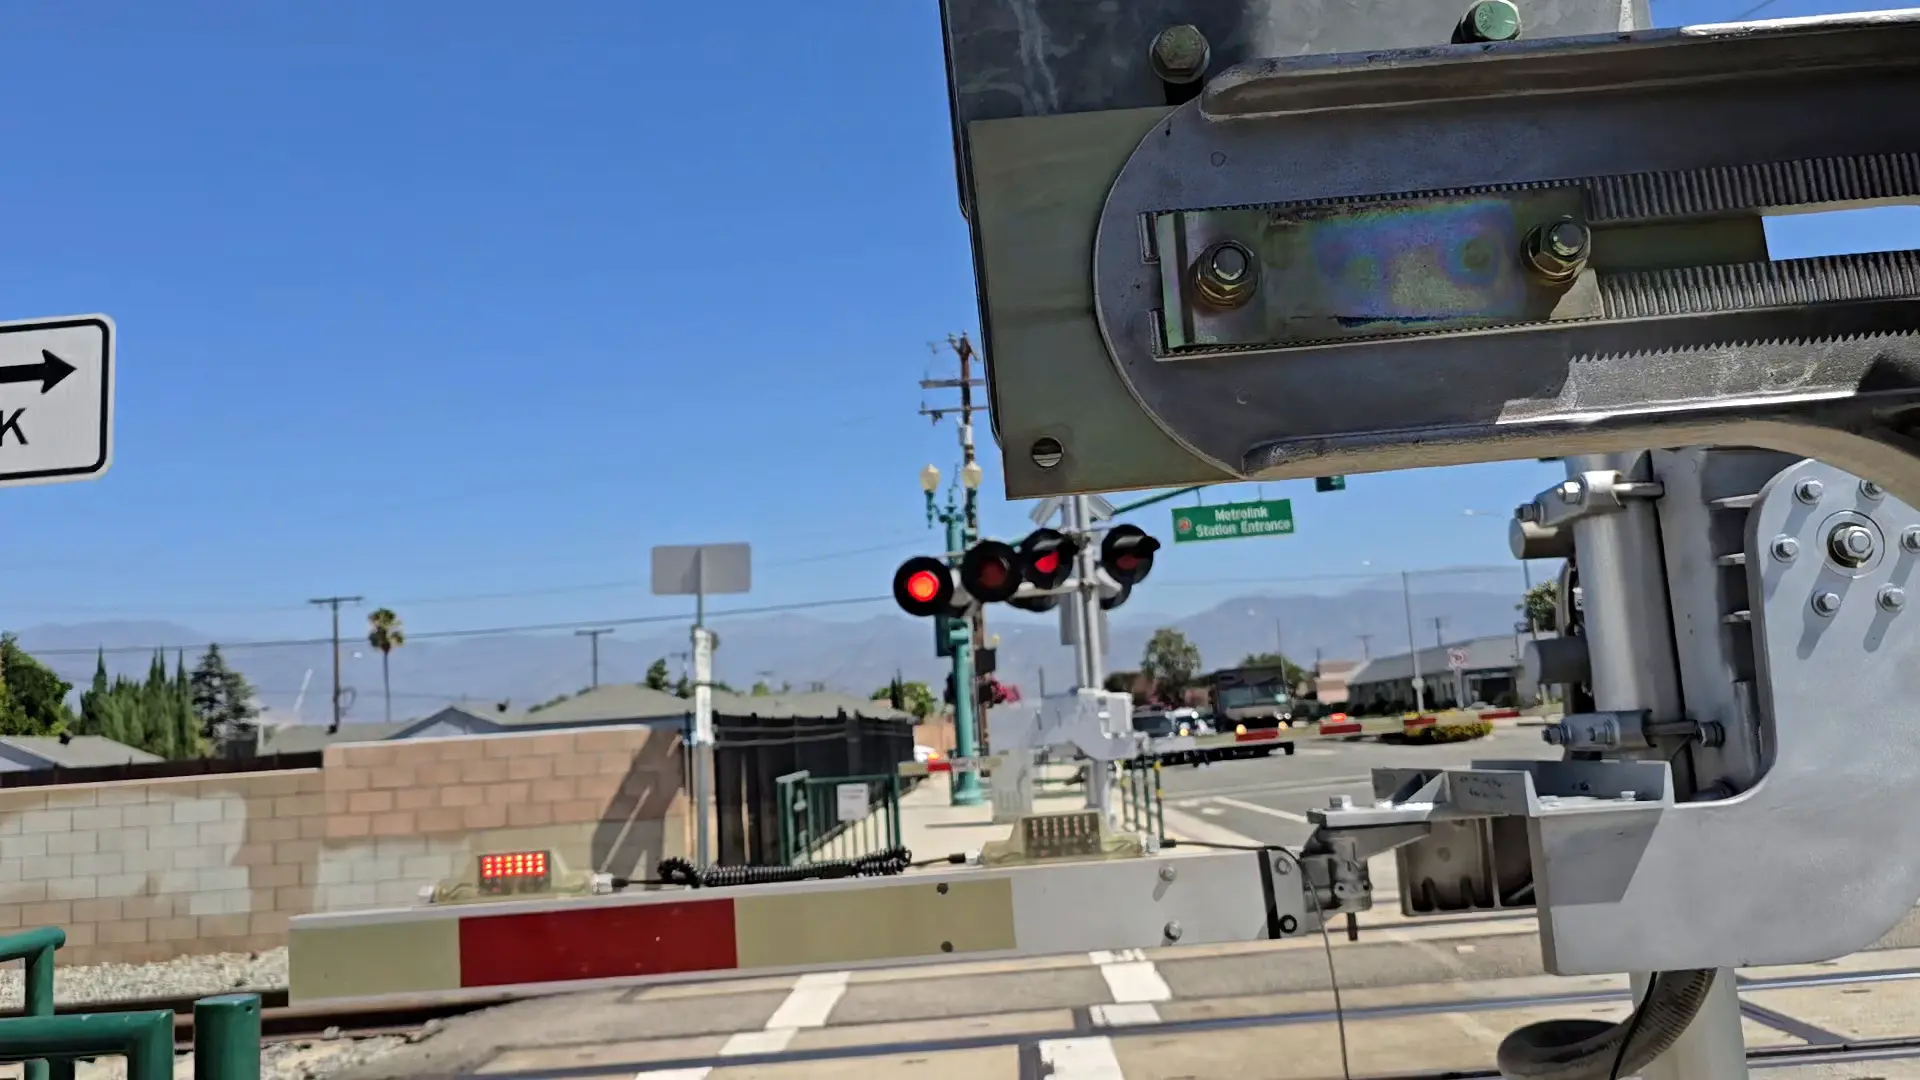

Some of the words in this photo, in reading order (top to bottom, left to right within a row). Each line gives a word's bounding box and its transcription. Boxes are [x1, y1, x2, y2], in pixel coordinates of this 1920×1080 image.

[1214, 506, 1268, 521] Metrolink
[1195, 523, 1237, 538] Station
[1240, 519, 1291, 534] Entrance
